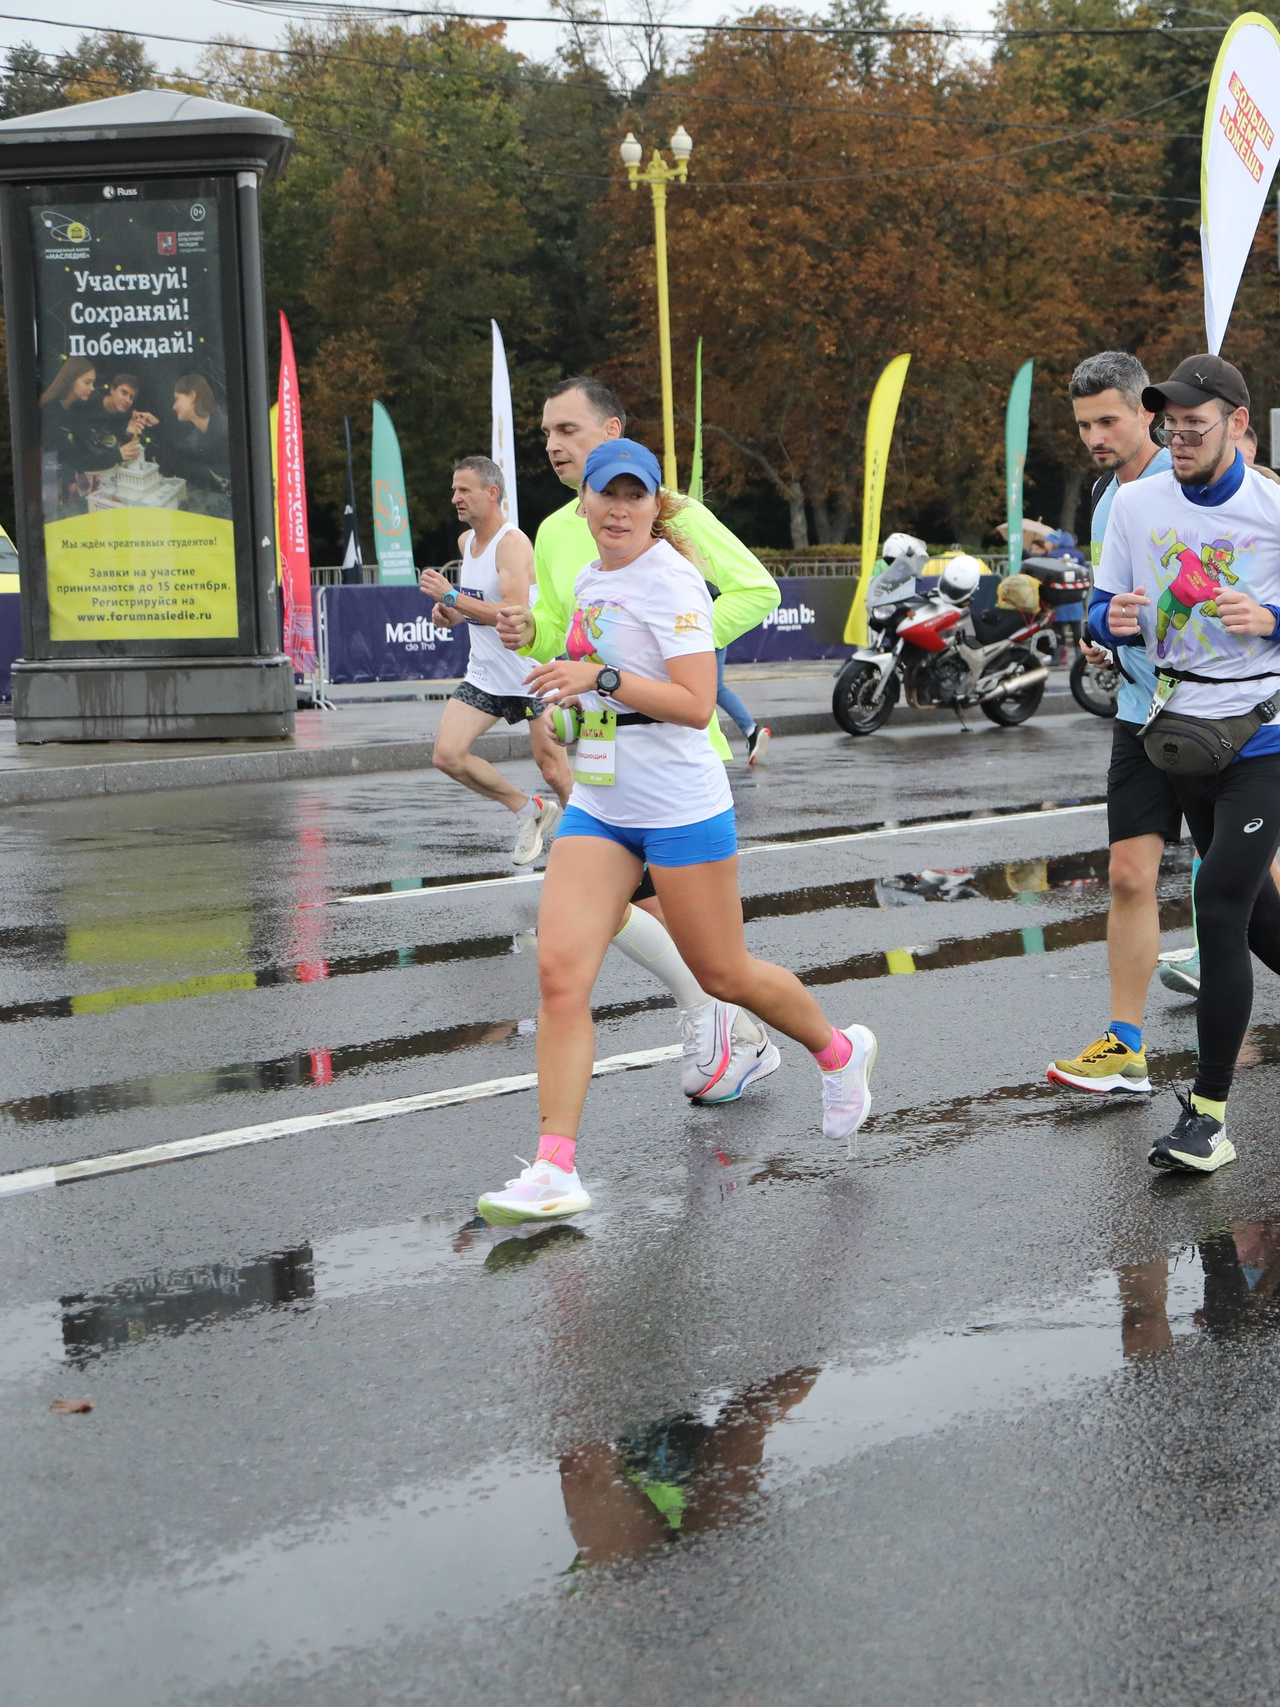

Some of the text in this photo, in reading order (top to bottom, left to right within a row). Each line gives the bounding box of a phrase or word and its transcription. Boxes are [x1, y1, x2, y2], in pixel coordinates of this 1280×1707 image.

[1230, 75, 1273, 149] БОЛЬШЕ
[1236, 106, 1257, 147] ЧЕМ
[117, 187, 138, 197] Russ
[74, 266, 188, 295] Участвуй!
[71, 298, 189, 328] Сохраняй!
[69, 330, 194, 358] Побеждай!
[61, 536, 218, 551] Мы ждём креативных студентов!
[89, 567, 196, 579] Заявки на участие
[57, 581, 231, 595] принимаются до 15 сентября.
[92, 596, 195, 609] Регистрируйся на
[77, 610, 212, 622] www.forumnasledie.ru
[762, 605, 799, 630] plan
[405, 642, 419, 651] de
